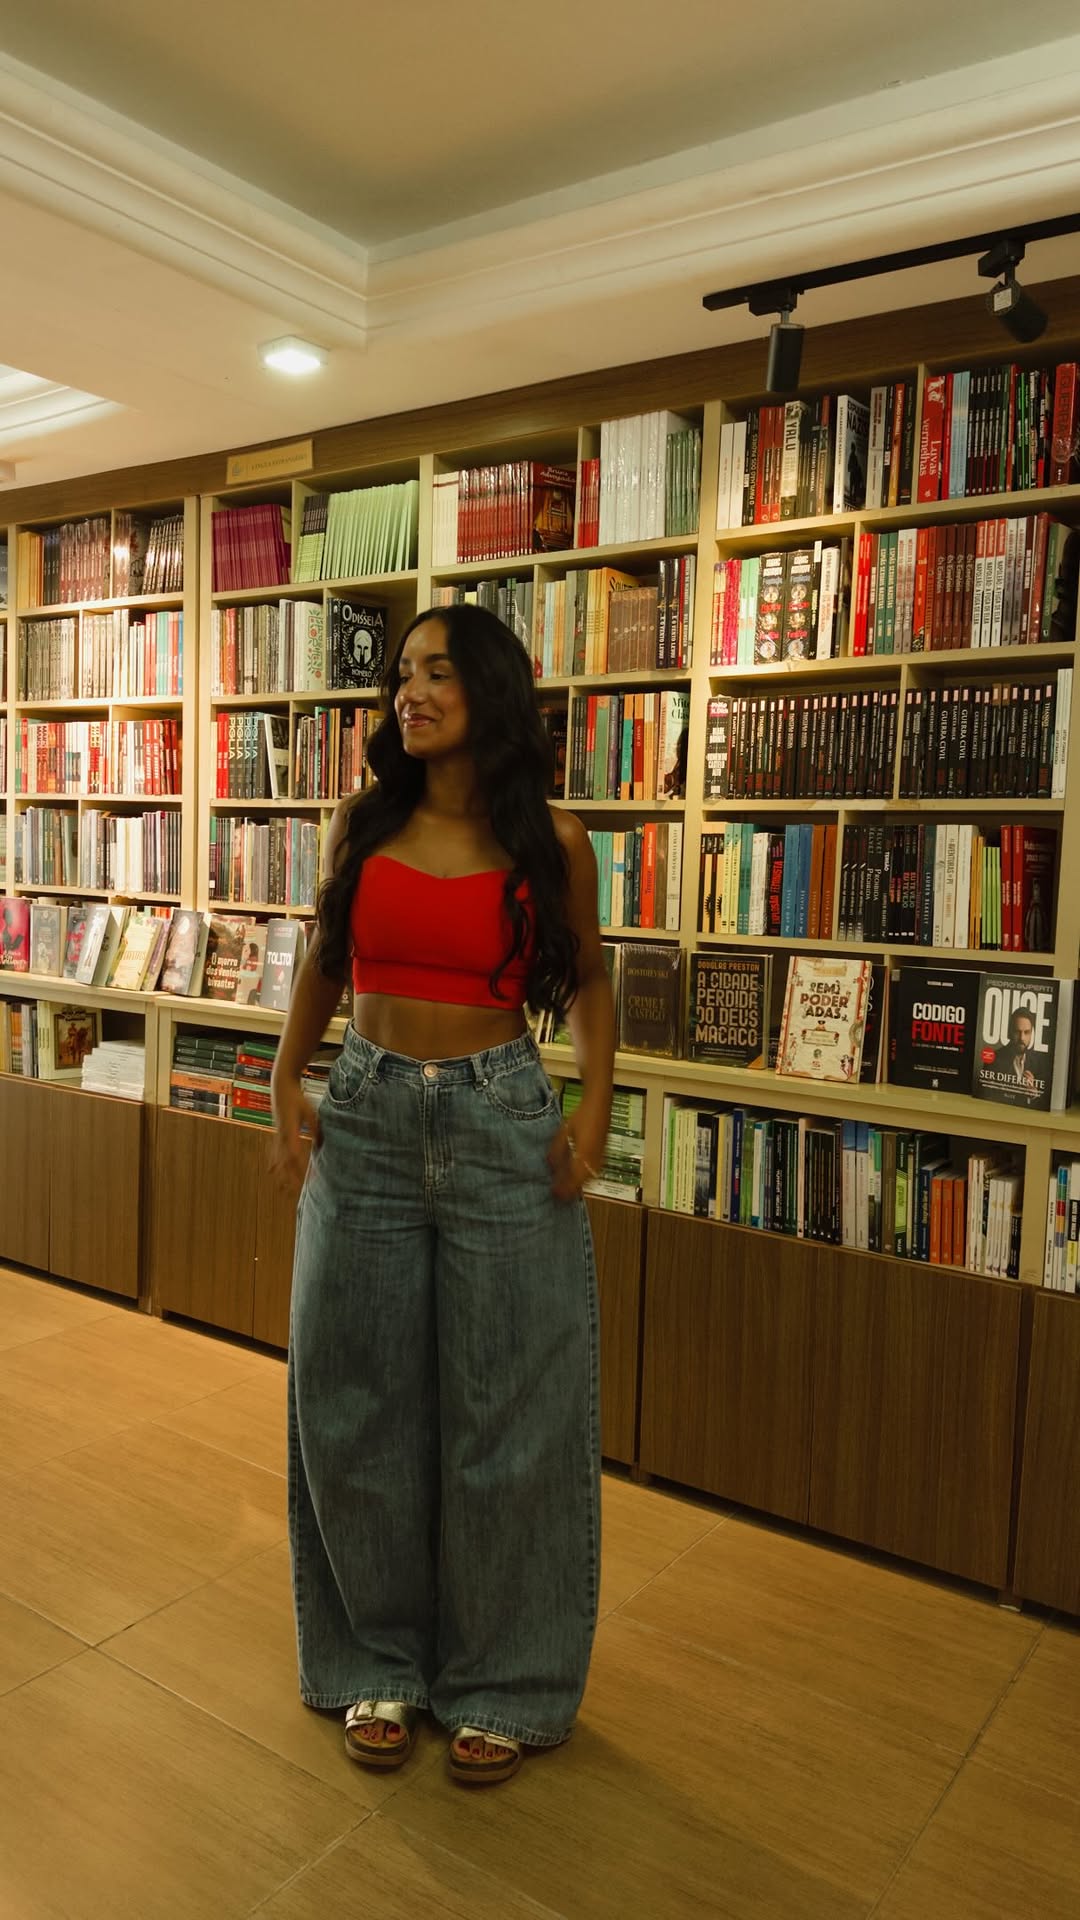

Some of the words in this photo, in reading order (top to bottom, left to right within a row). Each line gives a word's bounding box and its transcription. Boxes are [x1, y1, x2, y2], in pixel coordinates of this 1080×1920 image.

[919, 418, 931, 477] vermelhas
[929, 440, 941, 476] Luvas
[984, 592, 992, 605] FUGA
[995, 591, 1003, 604] FUGA
[342, 604, 384, 628] ODISSEIA
[658, 625, 666, 643] VENTO
[939, 709, 949, 740] GUERRA
[959, 708, 969, 738] GUERRA
[228, 716, 236, 760] PIGLIA
[236, 716, 244, 760] PIGLIA
[938, 740, 947, 761] CIVIL
[958, 739, 967, 761] CIVIL
[946, 843, 956, 875] AVENTURAS
[865, 867, 874, 901] PROIBIDA
[873, 868, 882, 902] PROIBIDA
[217, 956, 239, 967] morro
[697, 960, 728, 970] DOUGLAS
[728, 961, 760, 972] PRESTON
[207, 978, 236, 990] uivantes
[697, 971, 706, 988] A
[710, 972, 760, 991] CIDADE
[986, 979, 1016, 989] PEDRO
[696, 988, 759, 1010] PERDIDA
[800, 993, 849, 1009] PODER
[695, 1006, 715, 1026] DO
[719, 1008, 759, 1028] DEUS
[695, 1024, 759, 1047] MACACO
[911, 1020, 966, 1046] FONTE
[979, 1069, 998, 1082] SER
[998, 1070, 1046, 1090] DIFERENTE
